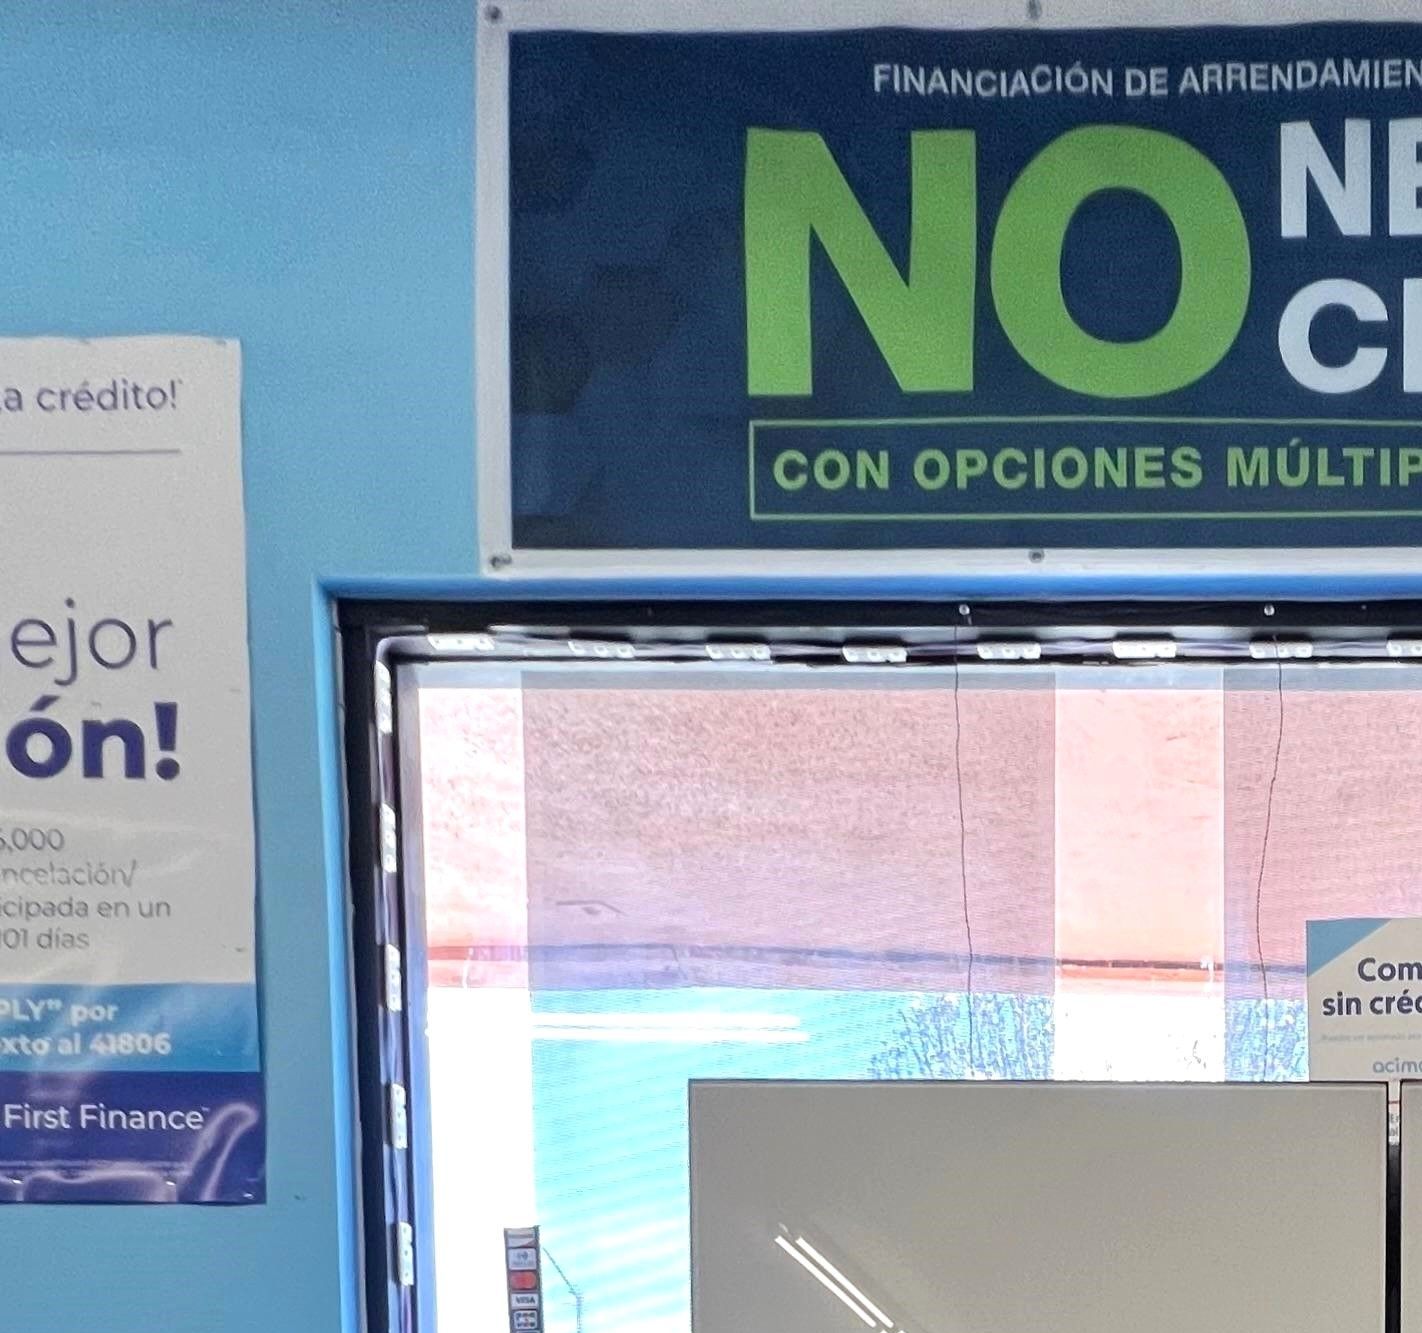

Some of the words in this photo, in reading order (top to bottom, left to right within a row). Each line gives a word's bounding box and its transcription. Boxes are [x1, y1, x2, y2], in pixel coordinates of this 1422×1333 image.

[873, 61, 1113, 97] FINANCIACIÓN
[1124, 67, 1168, 96] DE
[744, 124, 1252, 398] NO
[37, 378, 177, 412] crédito!
[773, 450, 889, 490] CON
[913, 446, 1203, 489] OPCIONES
[10, 597, 173, 686] ejor
[6, 695, 180, 781] ón!
[0, 896, 89, 922] cipada
[97, 900, 130, 919] en
[138, 900, 171, 919] un
[36, 926, 90, 949] días
[69, 1003, 119, 1026] por
[1322, 991, 1362, 1016] sin
[0, 1034, 50, 1055] xto
[57, 1032, 81, 1055] al
[90, 1031, 172, 1055] 41806
[4, 1104, 71, 1130] First
[80, 1103, 204, 1130] Finance
